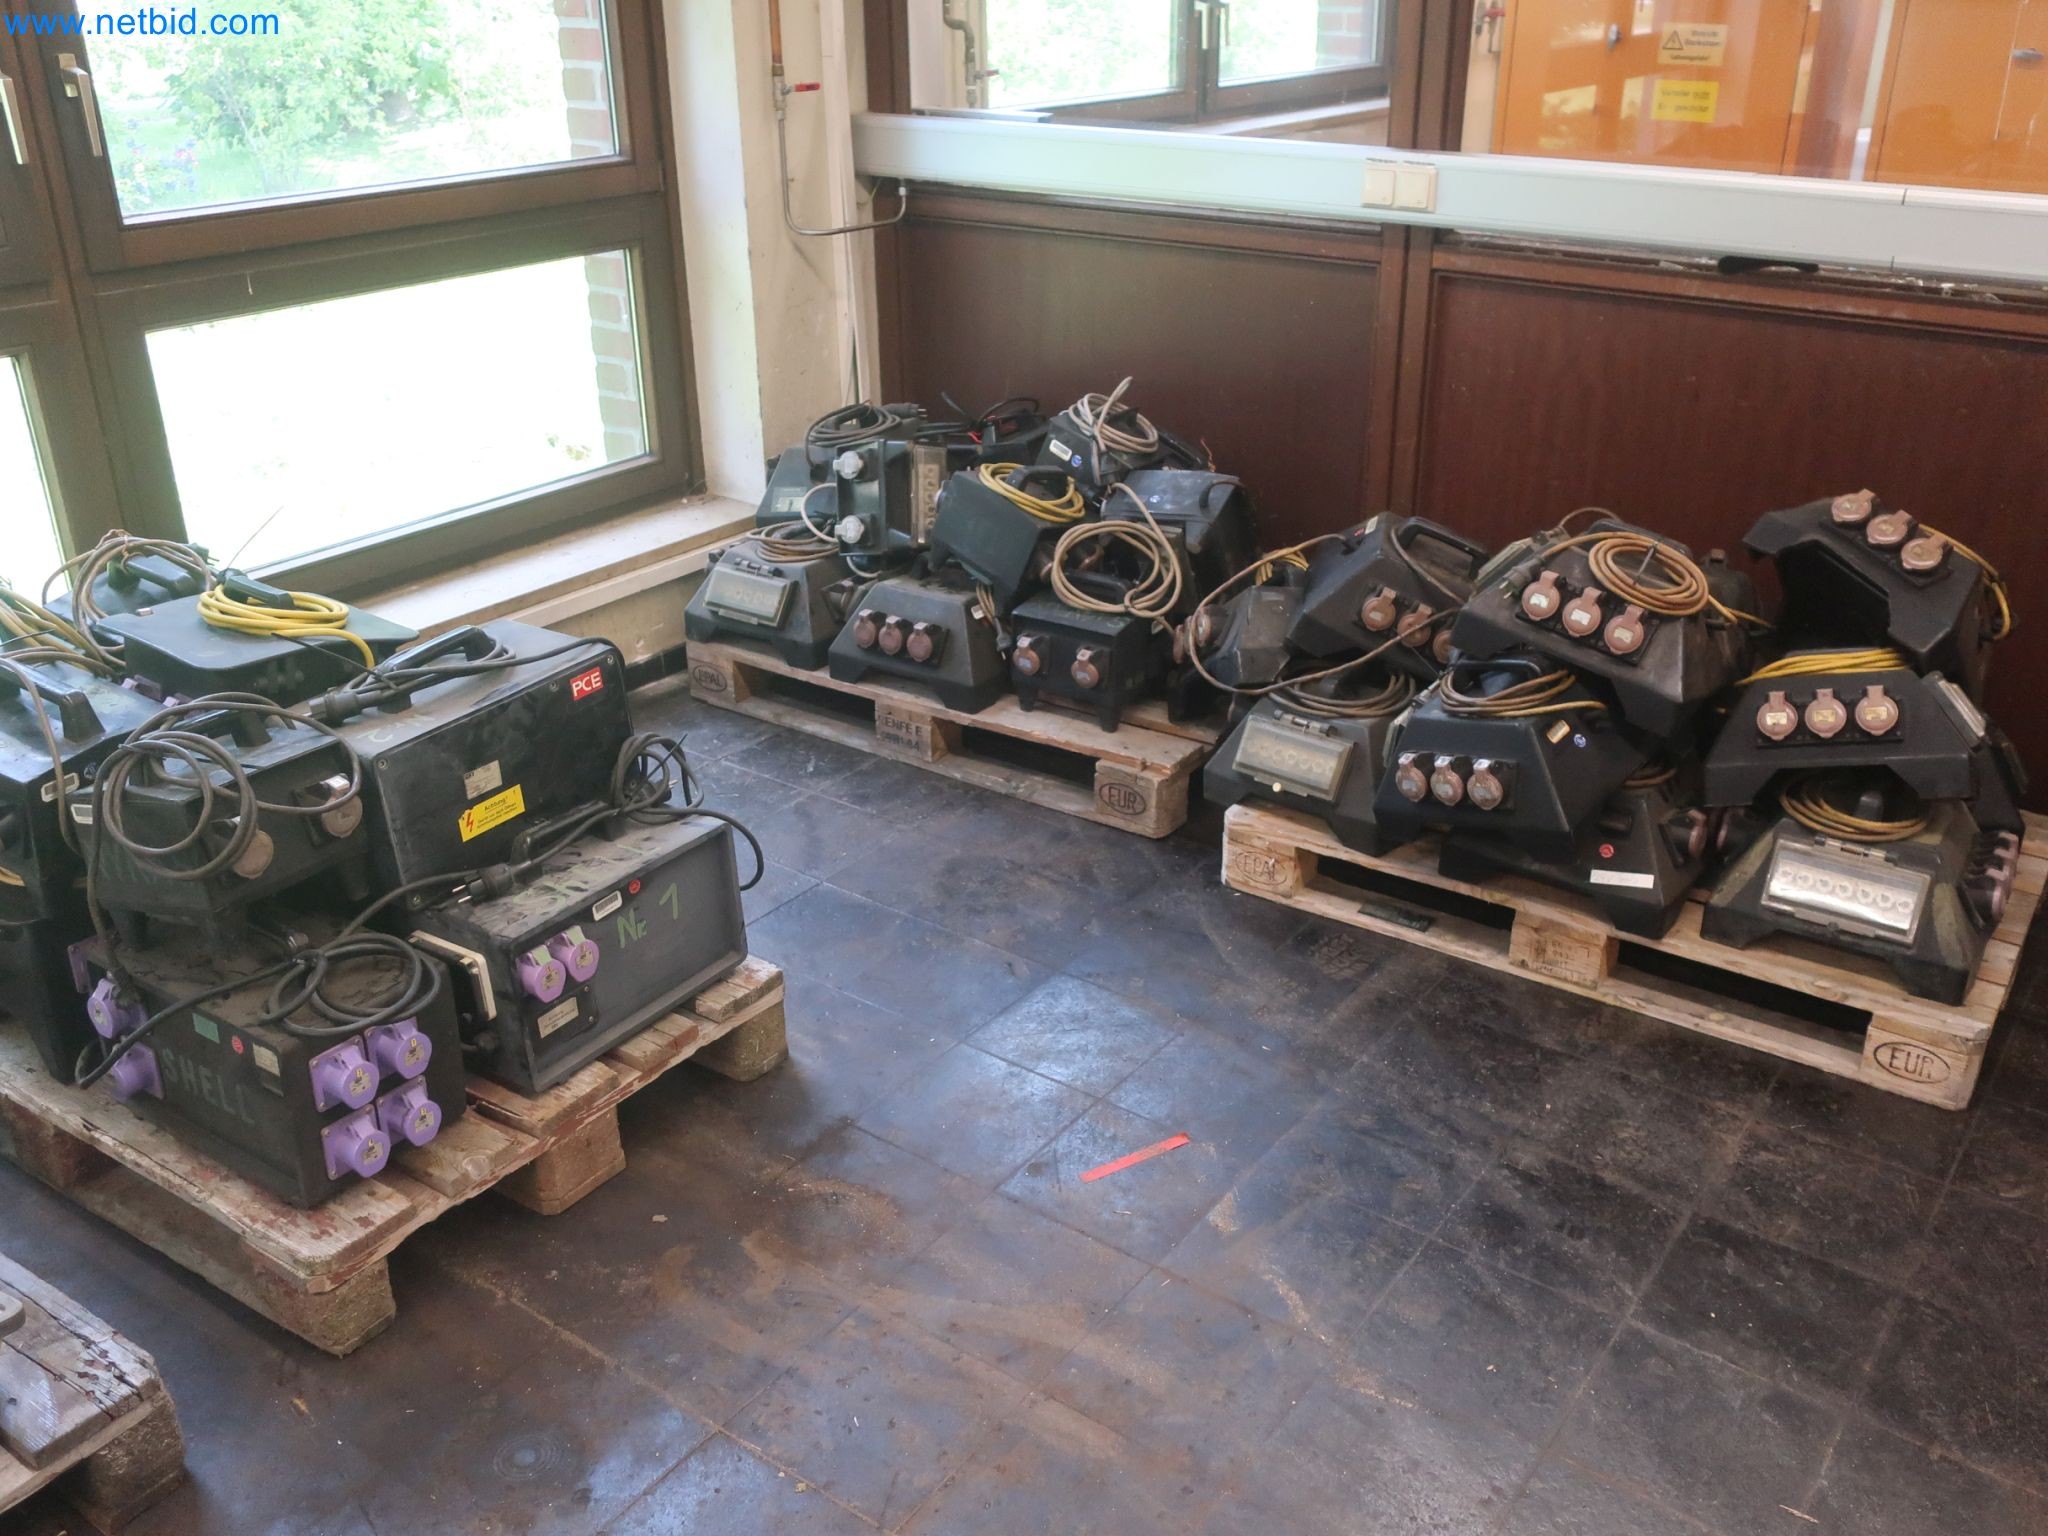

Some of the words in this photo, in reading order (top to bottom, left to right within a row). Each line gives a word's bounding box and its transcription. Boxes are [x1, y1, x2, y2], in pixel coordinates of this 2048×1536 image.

[572, 671, 602, 697] PCE
[1108, 786, 1137, 813] EUR
[162, 1047, 256, 1125] SHELL
